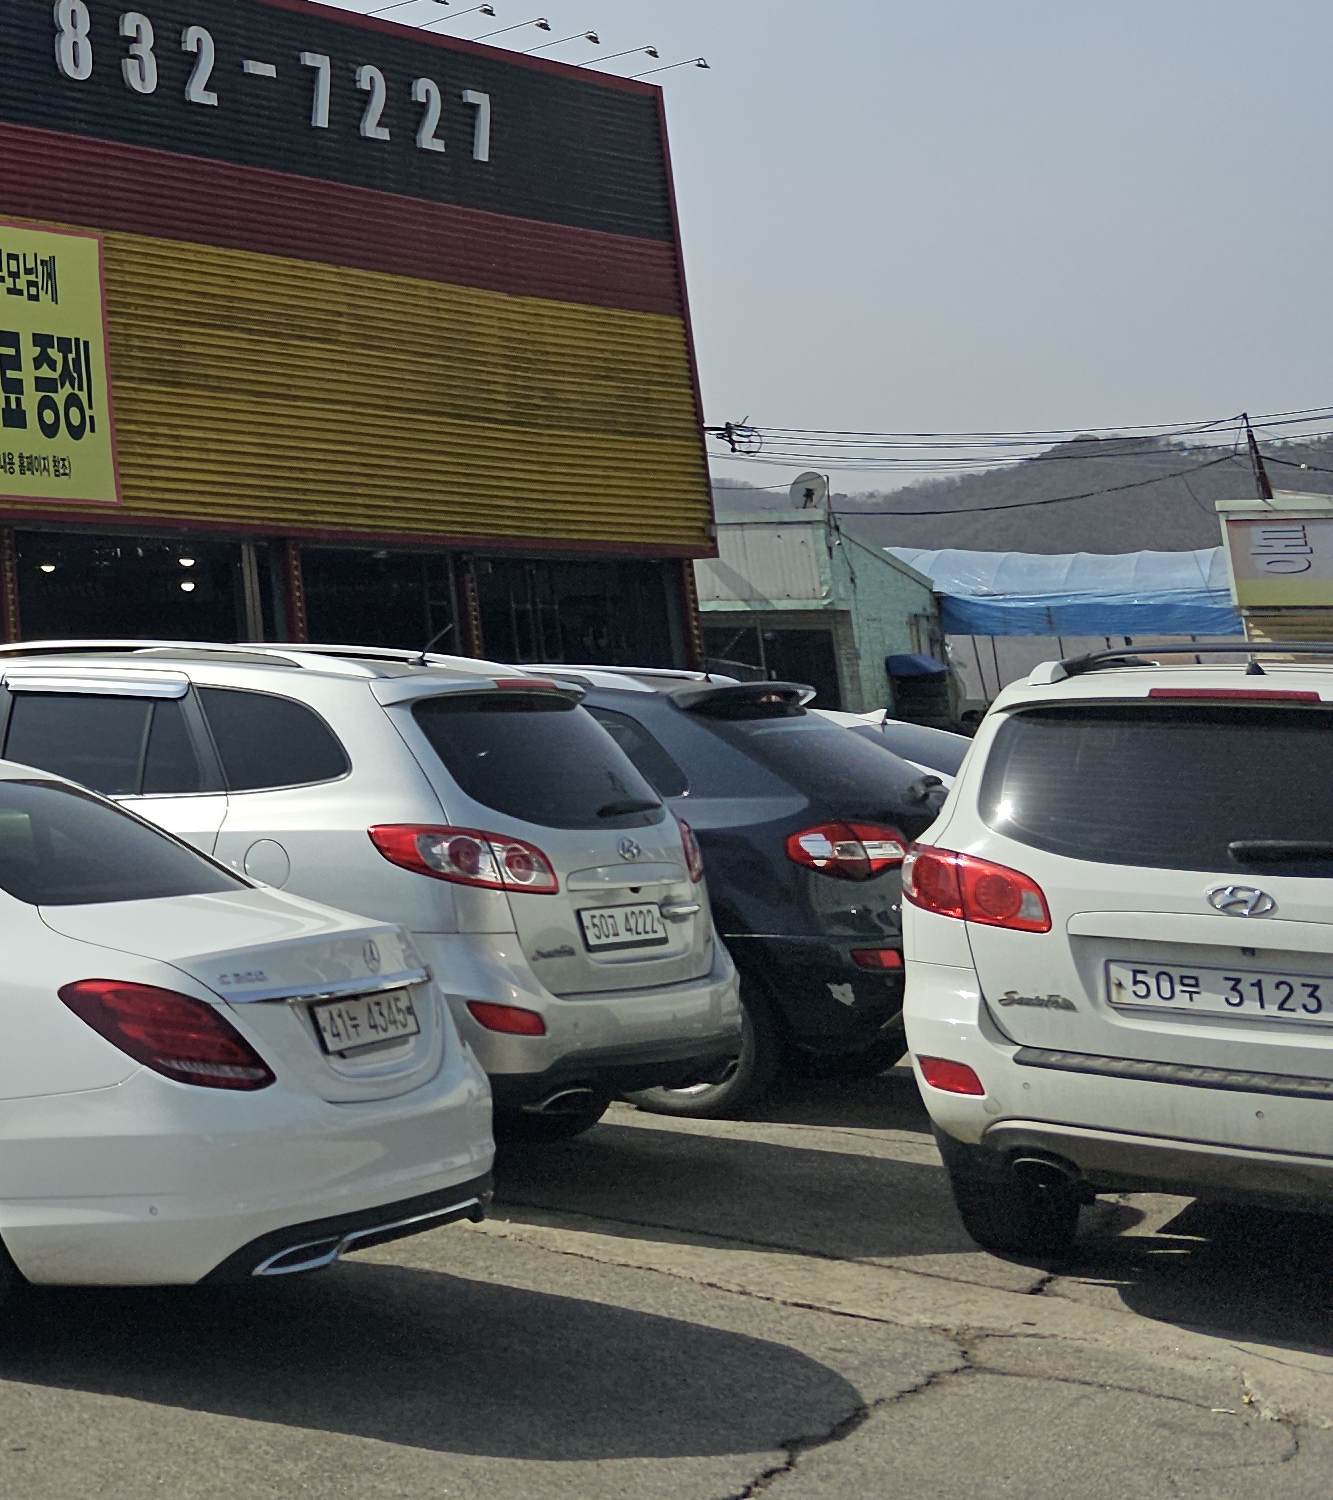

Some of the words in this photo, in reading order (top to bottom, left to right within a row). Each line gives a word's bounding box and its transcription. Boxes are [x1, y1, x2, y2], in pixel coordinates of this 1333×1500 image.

[32, 332, 96, 441] 증정!
[589, 912, 620, 940] 50고
[624, 909, 658, 936] 4222
[1131, 968, 1202, 1002] 50무
[1222, 975, 1324, 1015] 3123
[328, 1007, 360, 1043] 41누
[367, 996, 408, 1035] 4345
